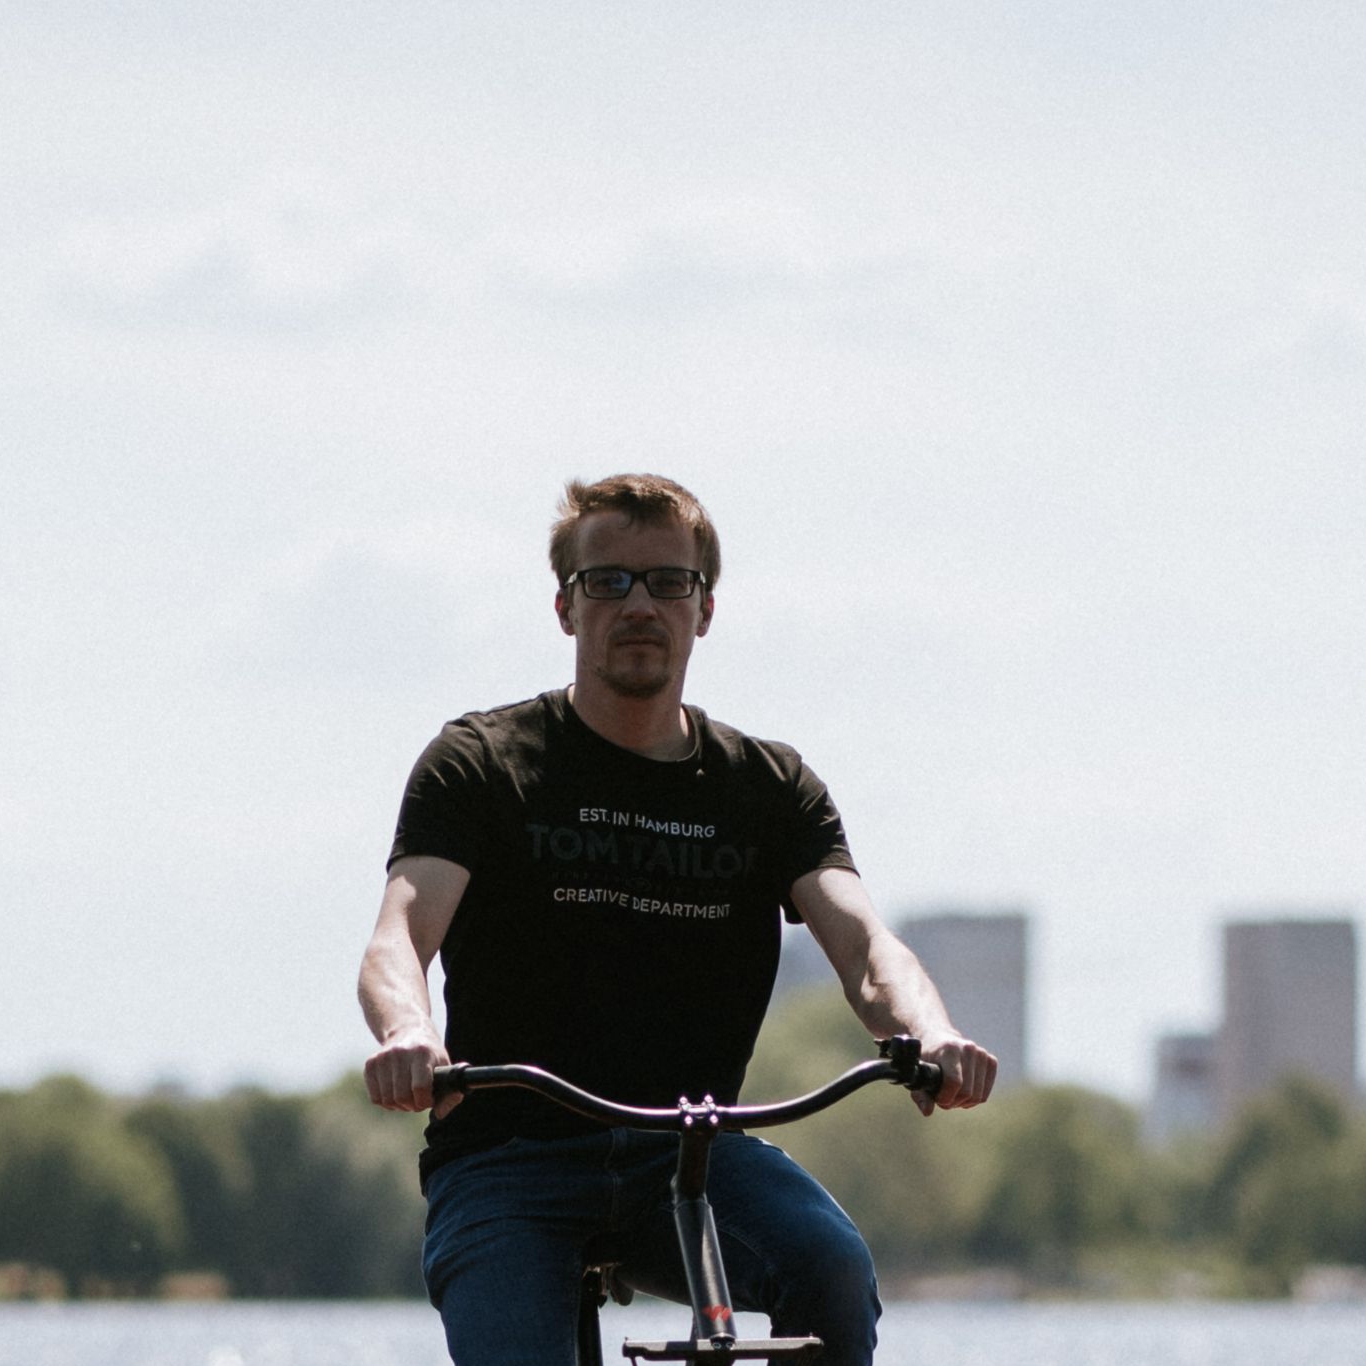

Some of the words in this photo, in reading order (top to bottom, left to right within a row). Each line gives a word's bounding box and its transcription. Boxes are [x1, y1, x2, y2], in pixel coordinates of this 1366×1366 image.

[579, 808, 610, 823] EST.
[613, 811, 630, 826] IN
[634, 813, 716, 838] HAMBURG
[526, 823, 619, 864] TOM
[553, 887, 629, 908] CREATIVE
[632, 896, 731, 919] DEPARTMENT
